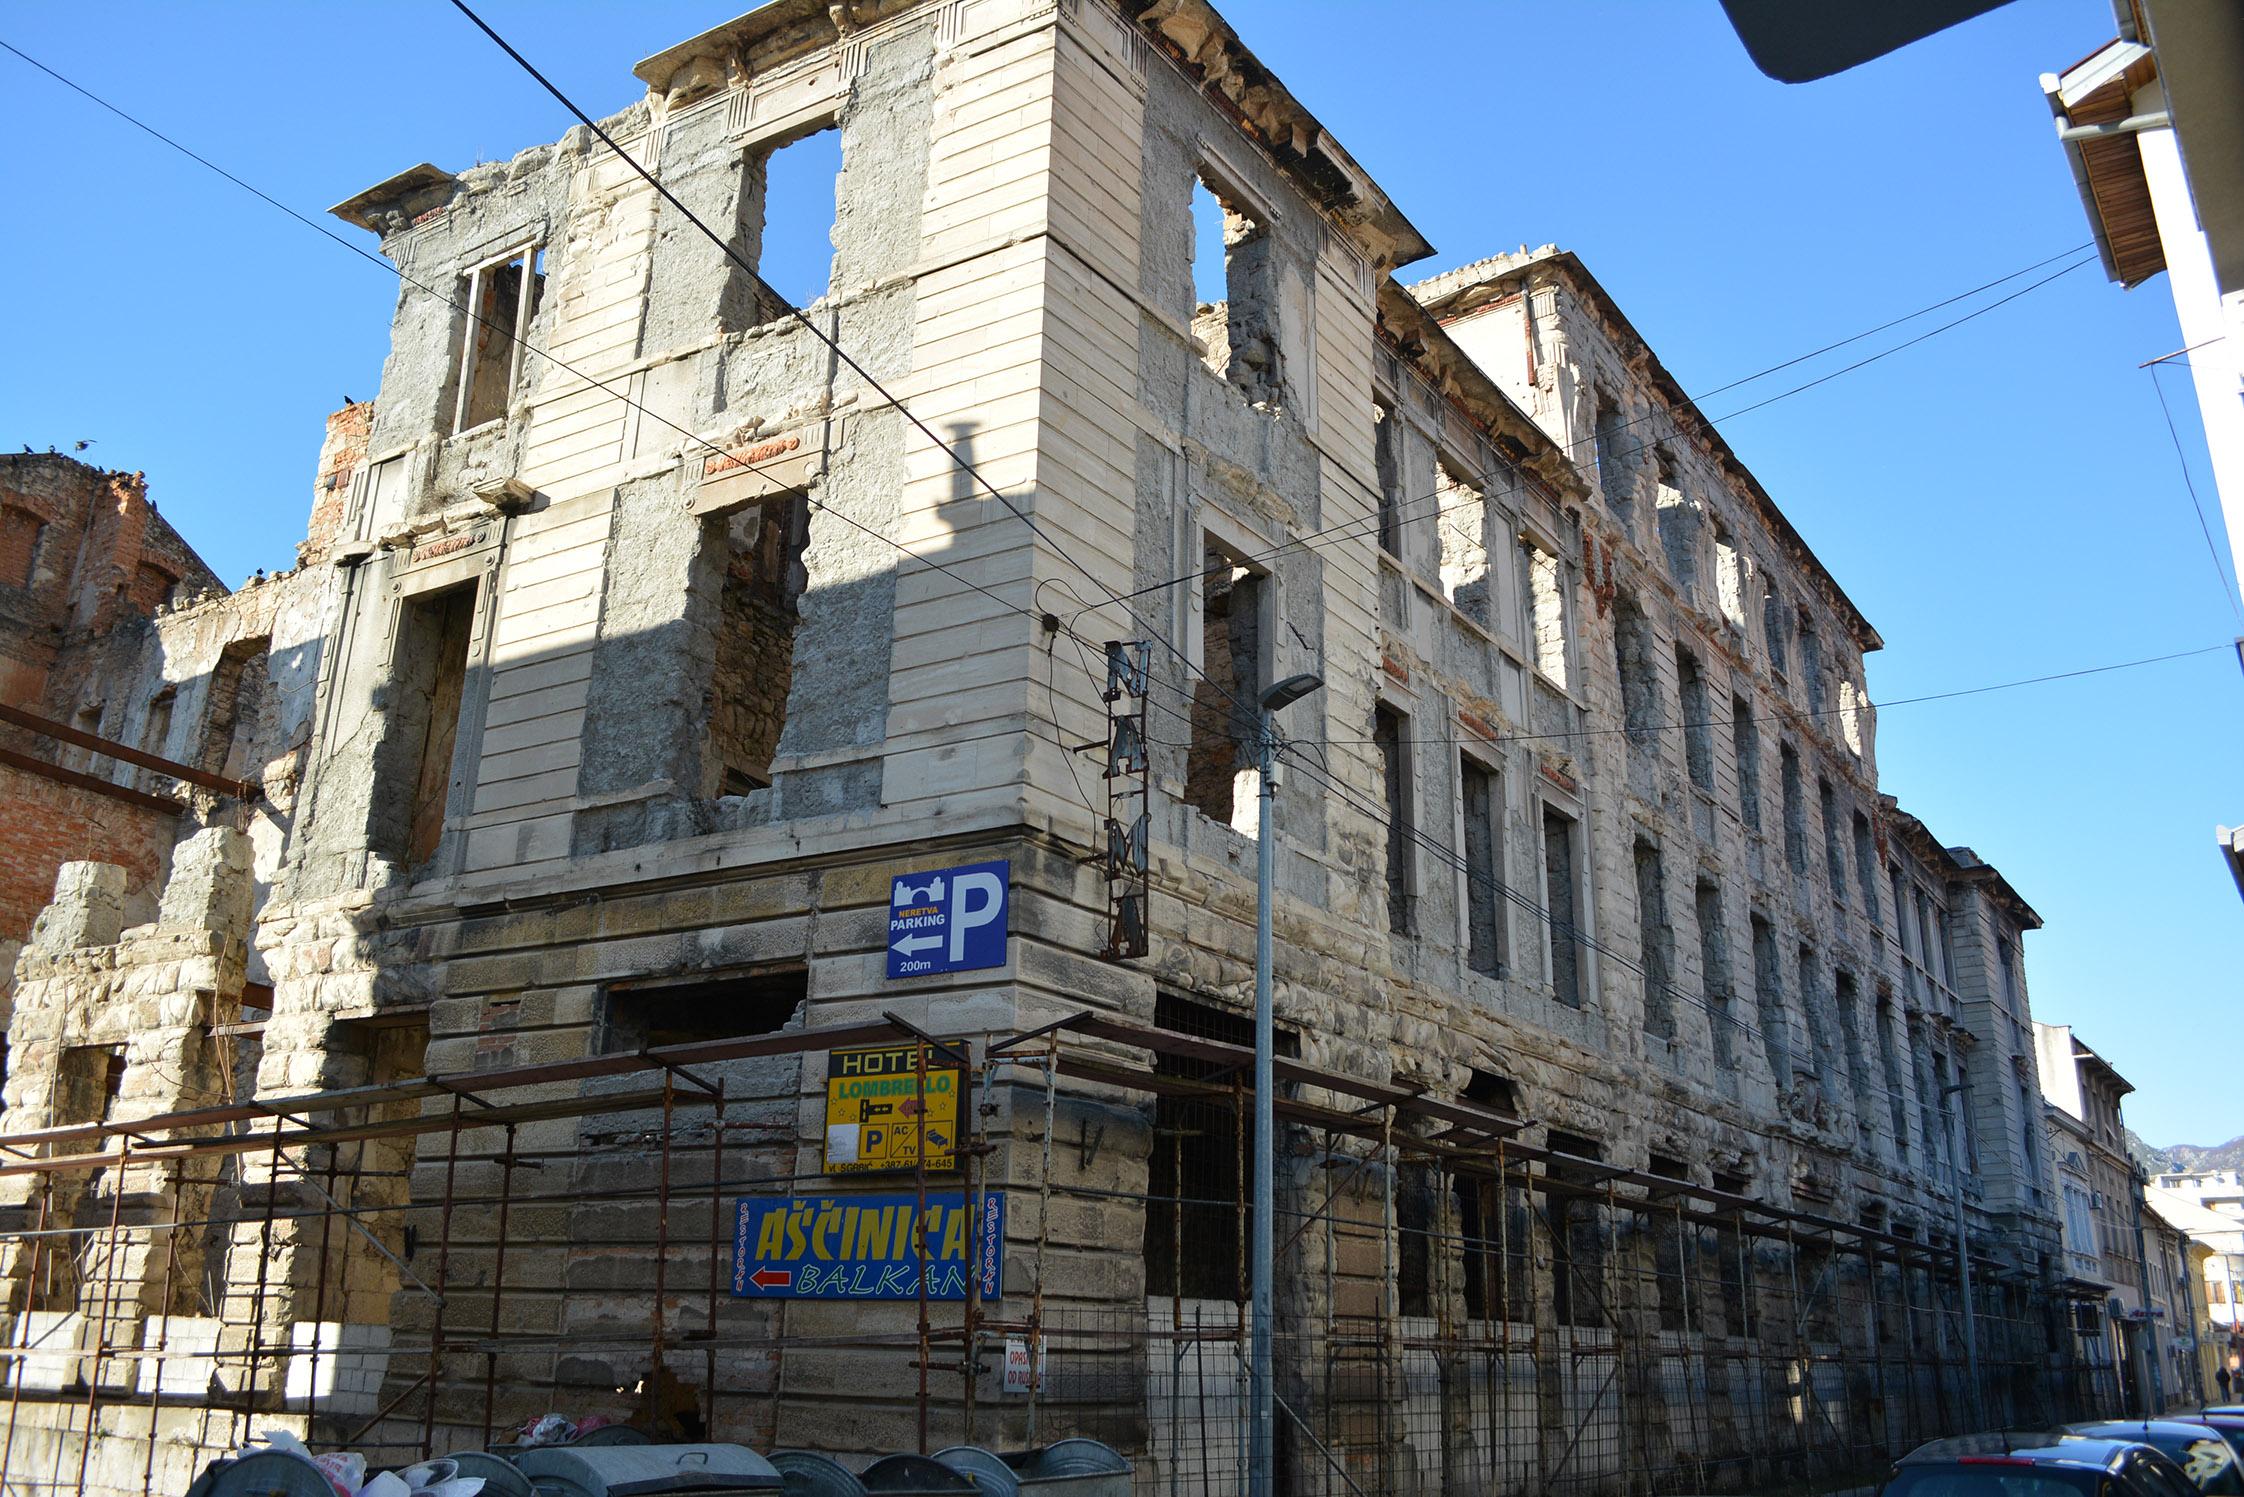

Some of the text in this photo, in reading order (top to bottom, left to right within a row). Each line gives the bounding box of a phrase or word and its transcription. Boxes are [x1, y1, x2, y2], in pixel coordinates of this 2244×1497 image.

[890, 914, 945, 931] PARKING
[898, 906, 938, 919] NERETVA
[949, 872, 1003, 962] P
[900, 960, 931, 972] 200m
[842, 1049, 945, 1074] HOTEL
[838, 1075, 950, 1099] LOMBRELO
[865, 1130, 883, 1153] P
[893, 1125, 908, 1136] AC
[902, 1146, 917, 1156] TV
[754, 1199, 976, 1261] AŠČINICA
[734, 1202, 750, 1292] RESTORAN
[982, 1197, 999, 1295] RESTORAN
[796, 1263, 977, 1295] BALKAN
